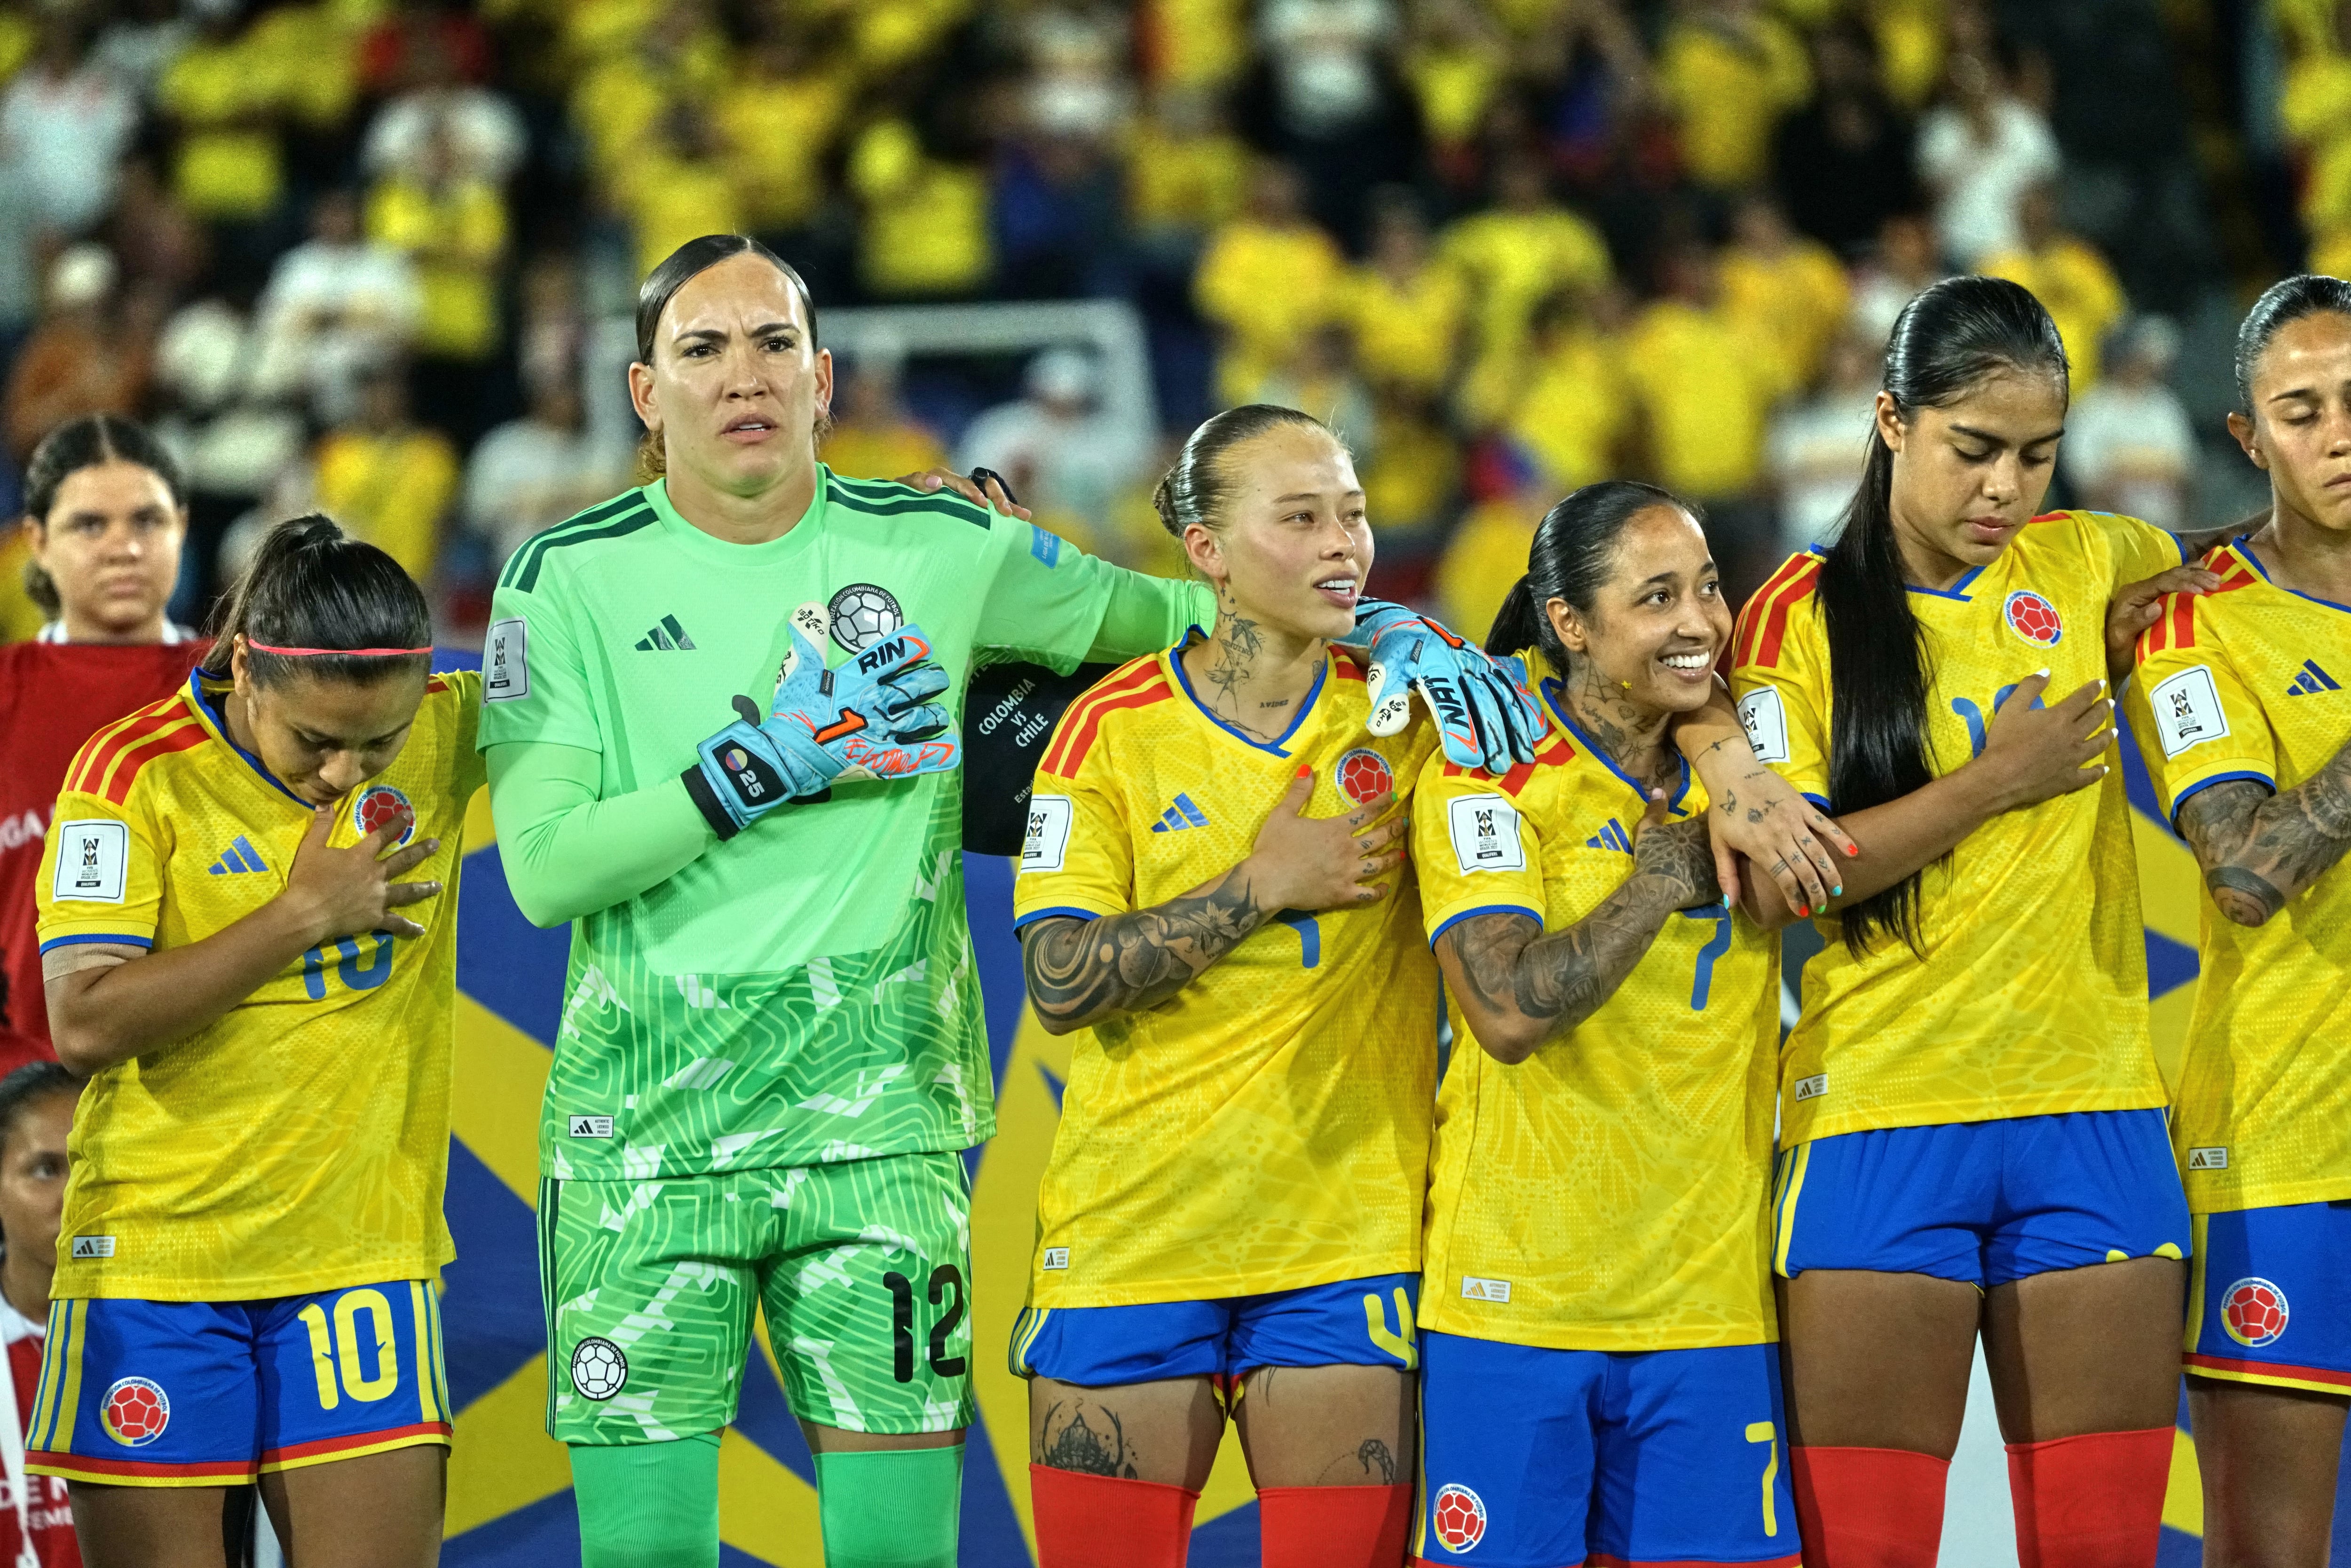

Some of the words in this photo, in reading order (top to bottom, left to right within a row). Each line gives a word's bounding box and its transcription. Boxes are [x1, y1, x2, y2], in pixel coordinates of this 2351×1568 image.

[843, 586, 878, 596] COLOMBIANA
[797, 609, 825, 635] EGOTIKO
[856, 638, 906, 676] RIN
[1412, 641, 1423, 661] RINAT
[979, 678, 1035, 735] COLOMBIA
[1010, 711, 1027, 726] VS
[1376, 701, 1406, 727] EGOTIKO
[1016, 713, 1049, 747] CHILE
[1346, 749, 1373, 758] COLOMBIANA
[739, 769, 765, 798] 25
[1680, 903, 1732, 1011] 7
[883, 1263, 966, 1384] 12
[1363, 1286, 1418, 1371] 4
[298, 1287, 399, 1411] 10
[584, 1339, 611, 1349] COLOMBIANA
[122, 1379, 154, 1389] COLOMBIANA
[1744, 1421, 1779, 1537] 7
